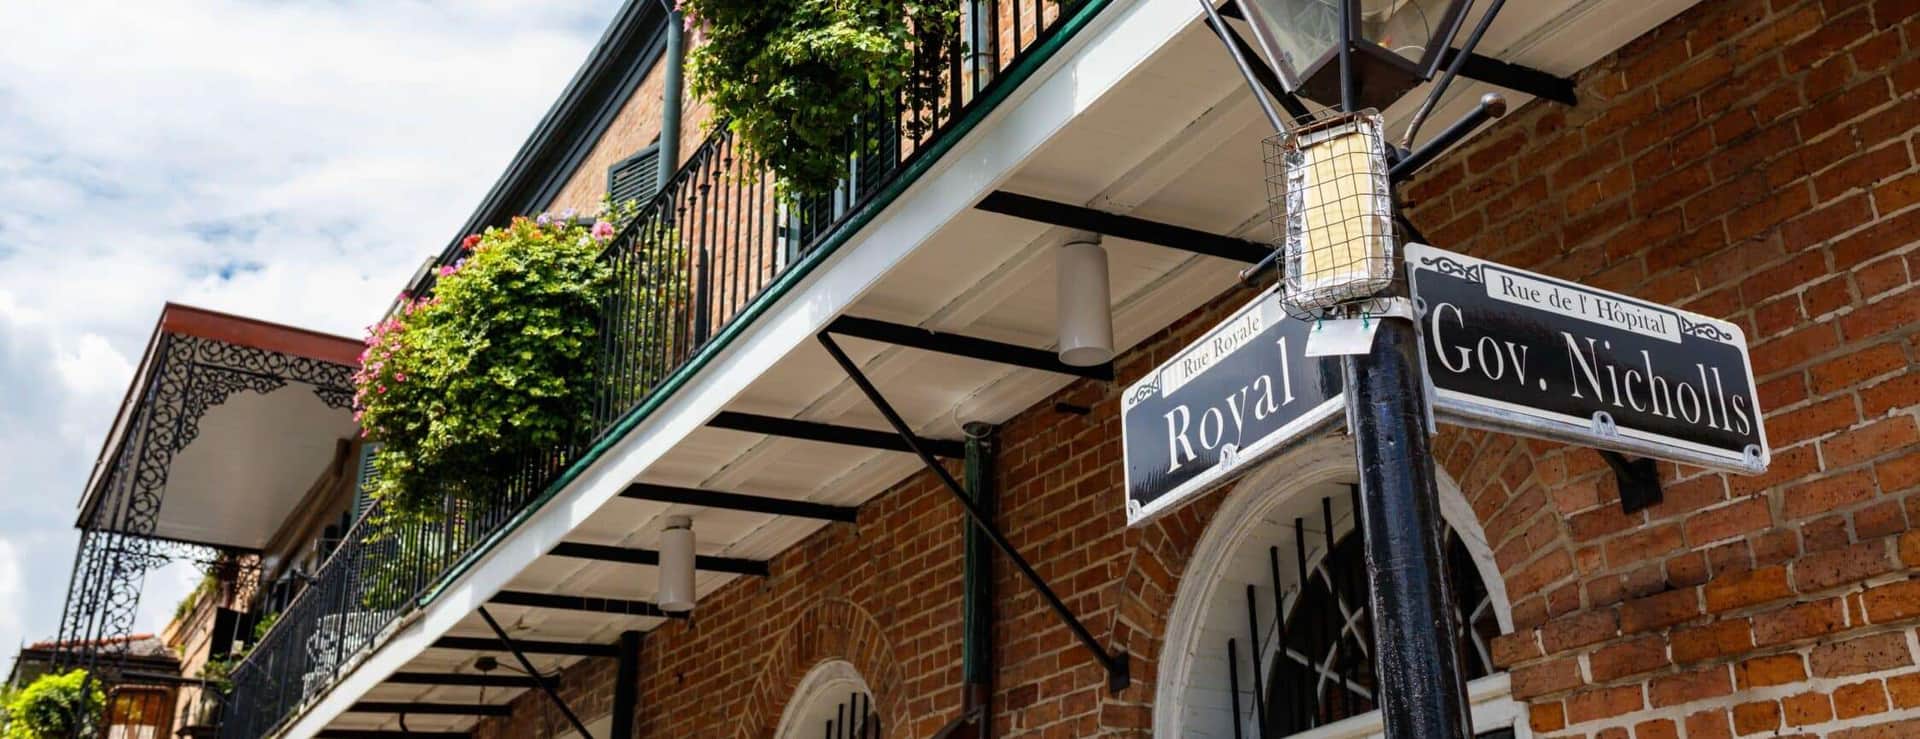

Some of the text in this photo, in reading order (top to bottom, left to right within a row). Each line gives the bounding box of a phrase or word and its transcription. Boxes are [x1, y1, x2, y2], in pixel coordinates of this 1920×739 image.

[1183, 315, 1260, 379] Rue Royale
[1501, 276, 1541, 303] Rue
[1549, 288, 1573, 310] de
[1594, 298, 1668, 335] Hôpital
[1163, 336, 1296, 474] Royal
[1431, 302, 1751, 436] Gov. Nicholls
